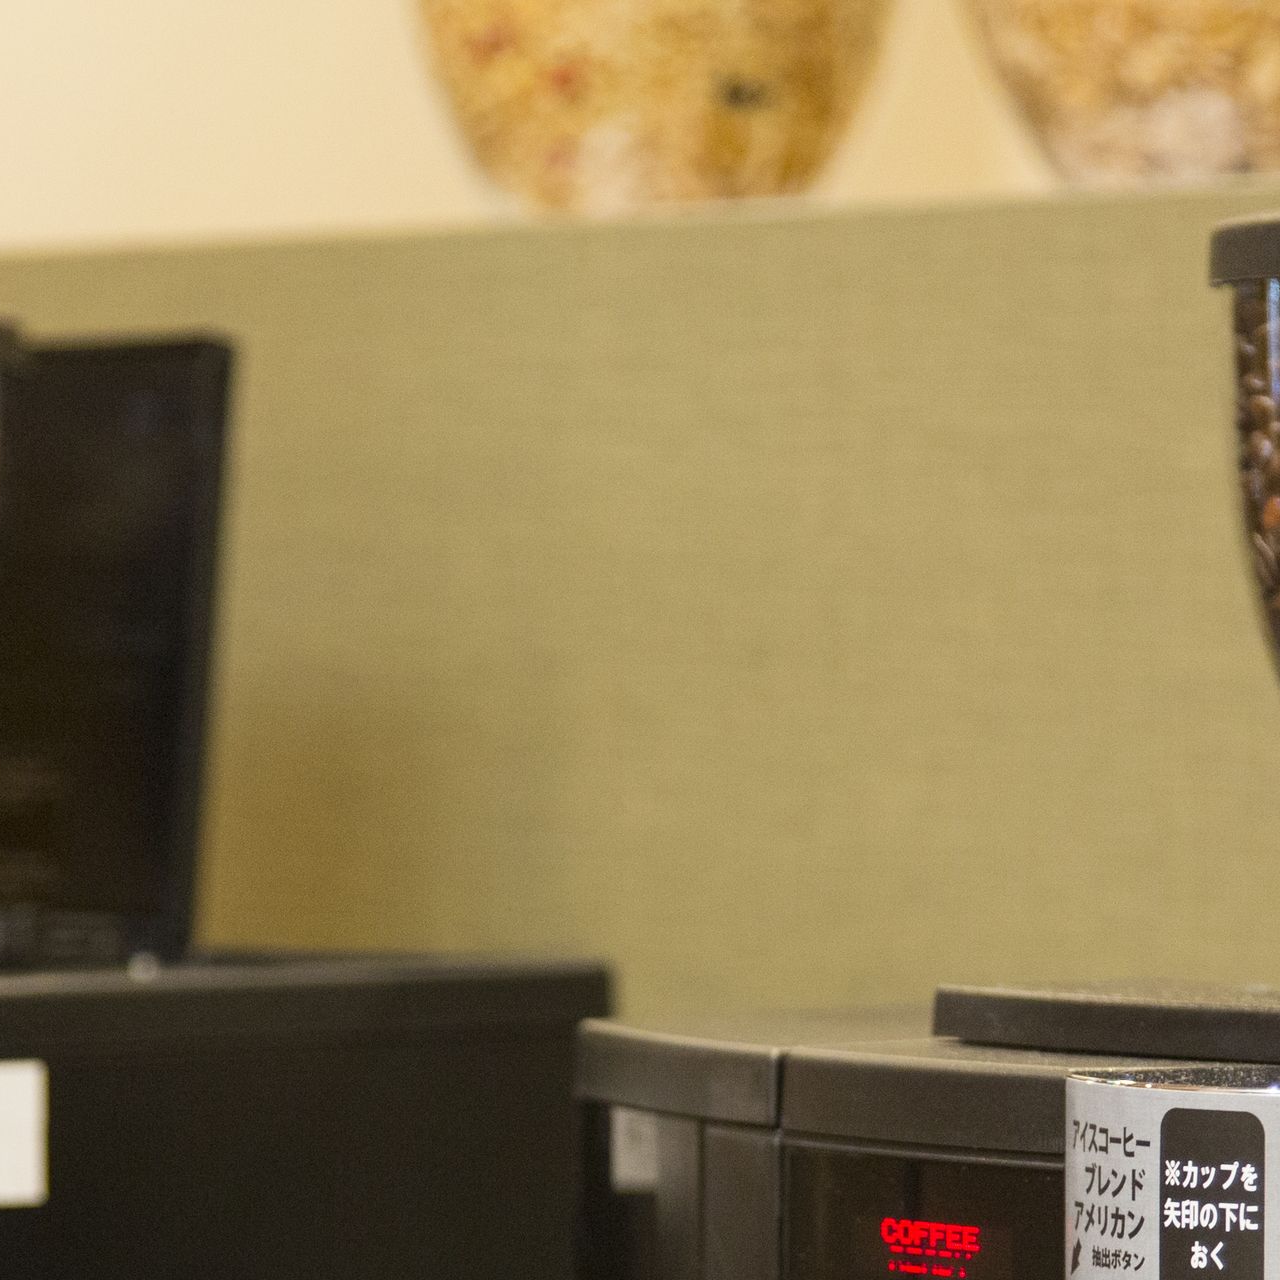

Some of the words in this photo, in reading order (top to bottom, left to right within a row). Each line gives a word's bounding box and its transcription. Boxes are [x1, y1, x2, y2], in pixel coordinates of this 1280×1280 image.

[1072, 1119, 1151, 1157] アイスコーヒー
[1084, 1163, 1146, 1201] ブレンド
[1164, 1159, 1258, 1192] ※カップを
[1074, 1201, 1145, 1239] アメリカン
[1163, 1197, 1259, 1232] 矢印の下に
[880, 1217, 981, 1253] COFFEE
[1092, 1248, 1145, 1271] 抽出ボタン
[1190, 1241, 1224, 1270] おく
